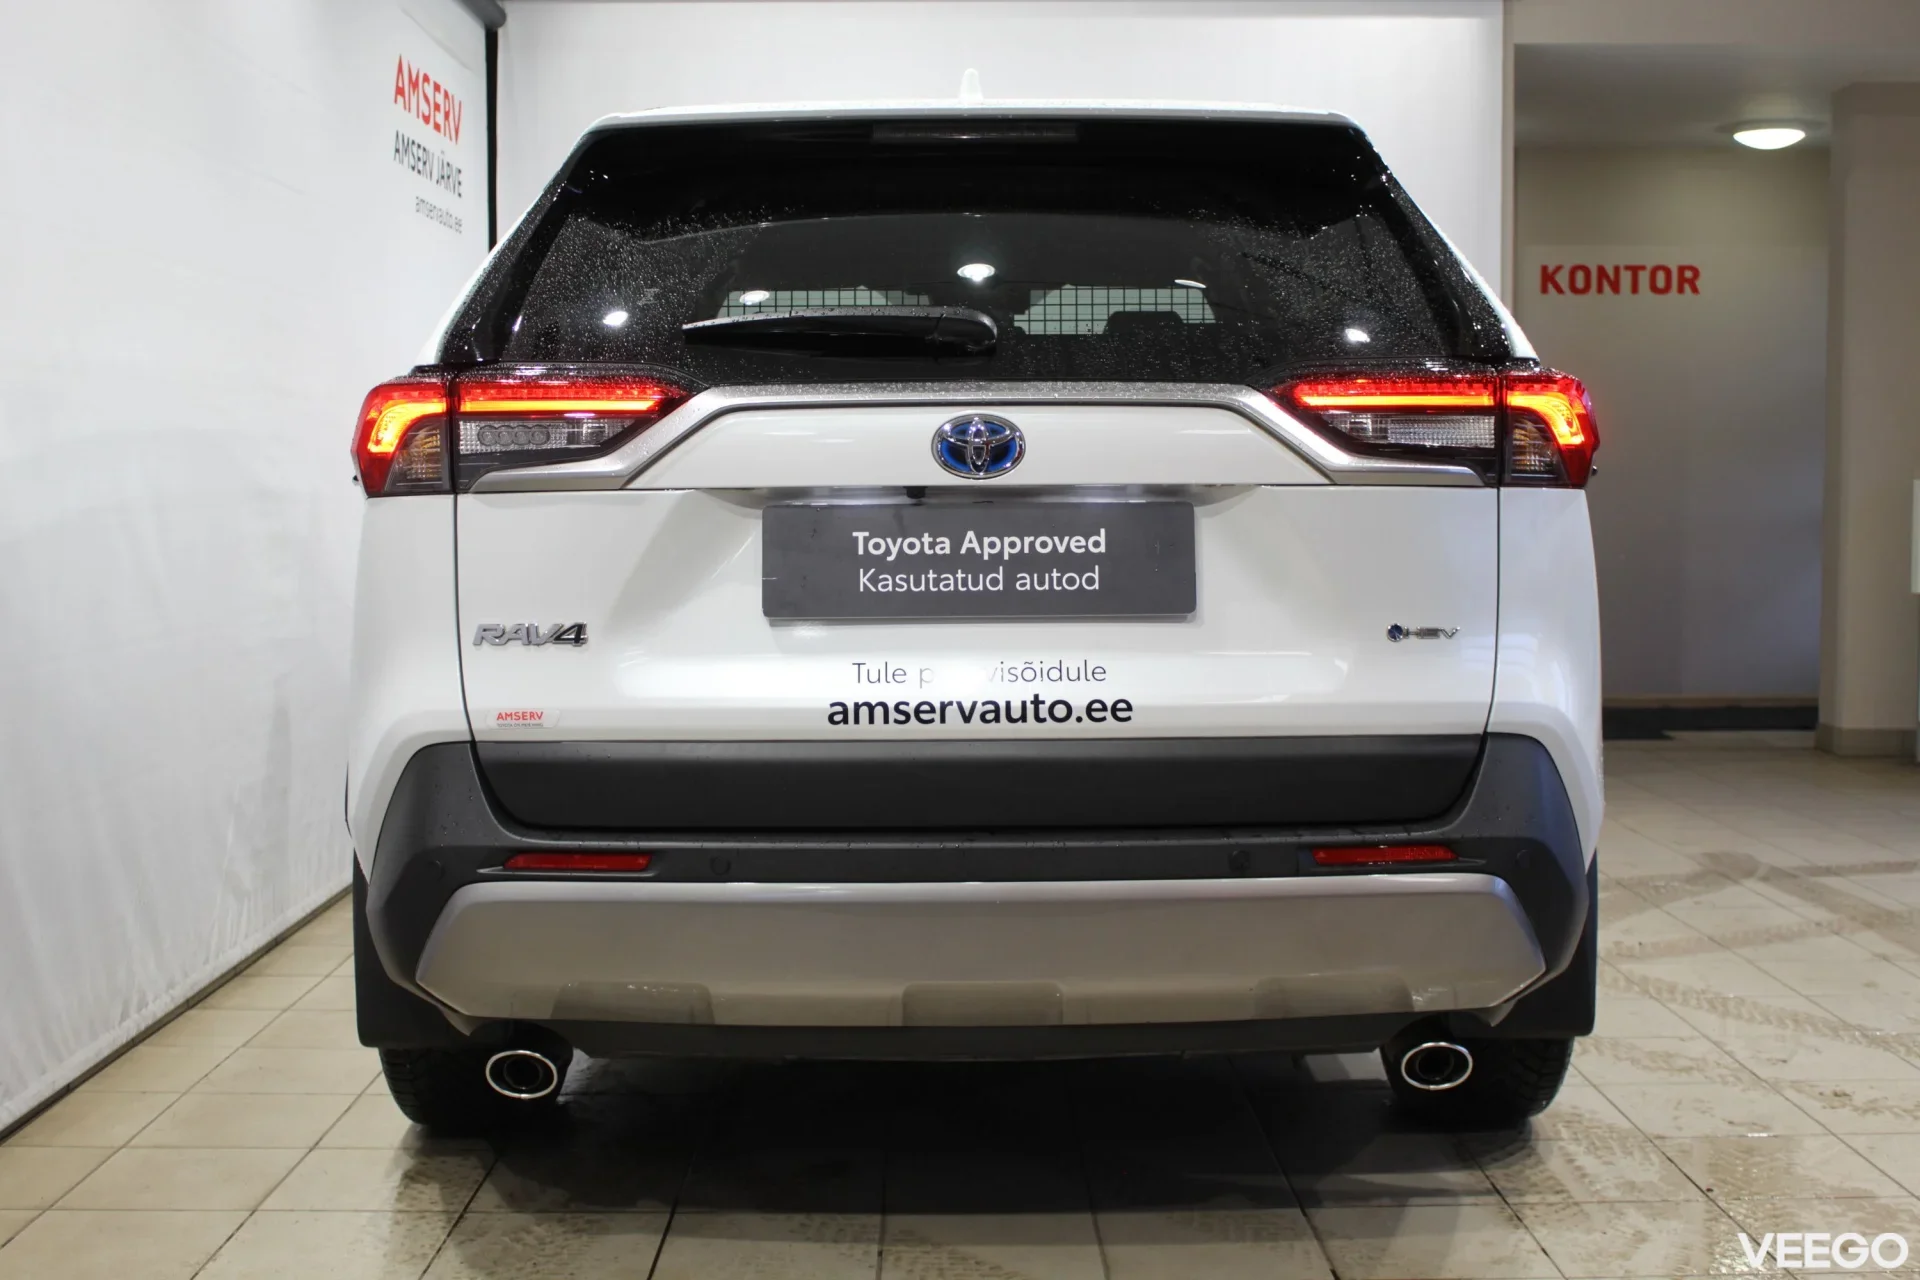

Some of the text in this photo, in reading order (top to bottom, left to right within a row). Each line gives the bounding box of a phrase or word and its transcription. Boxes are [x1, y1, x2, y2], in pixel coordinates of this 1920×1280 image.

[394, 53, 462, 145] AMSERV
[393, 129, 462, 198] AMSERV JÄRVE
[415, 195, 463, 234] amservauto.ee
[1540, 264, 1701, 295] KONTOR
[852, 528, 1106, 561] Toyota Approved
[858, 565, 1100, 592] Kasutatud autod
[473, 621, 588, 647] RAV4
[852, 659, 1107, 689] Tule pvisõidule
[496, 711, 544, 721] AMSERV
[827, 693, 1133, 725] amservauto.ee
